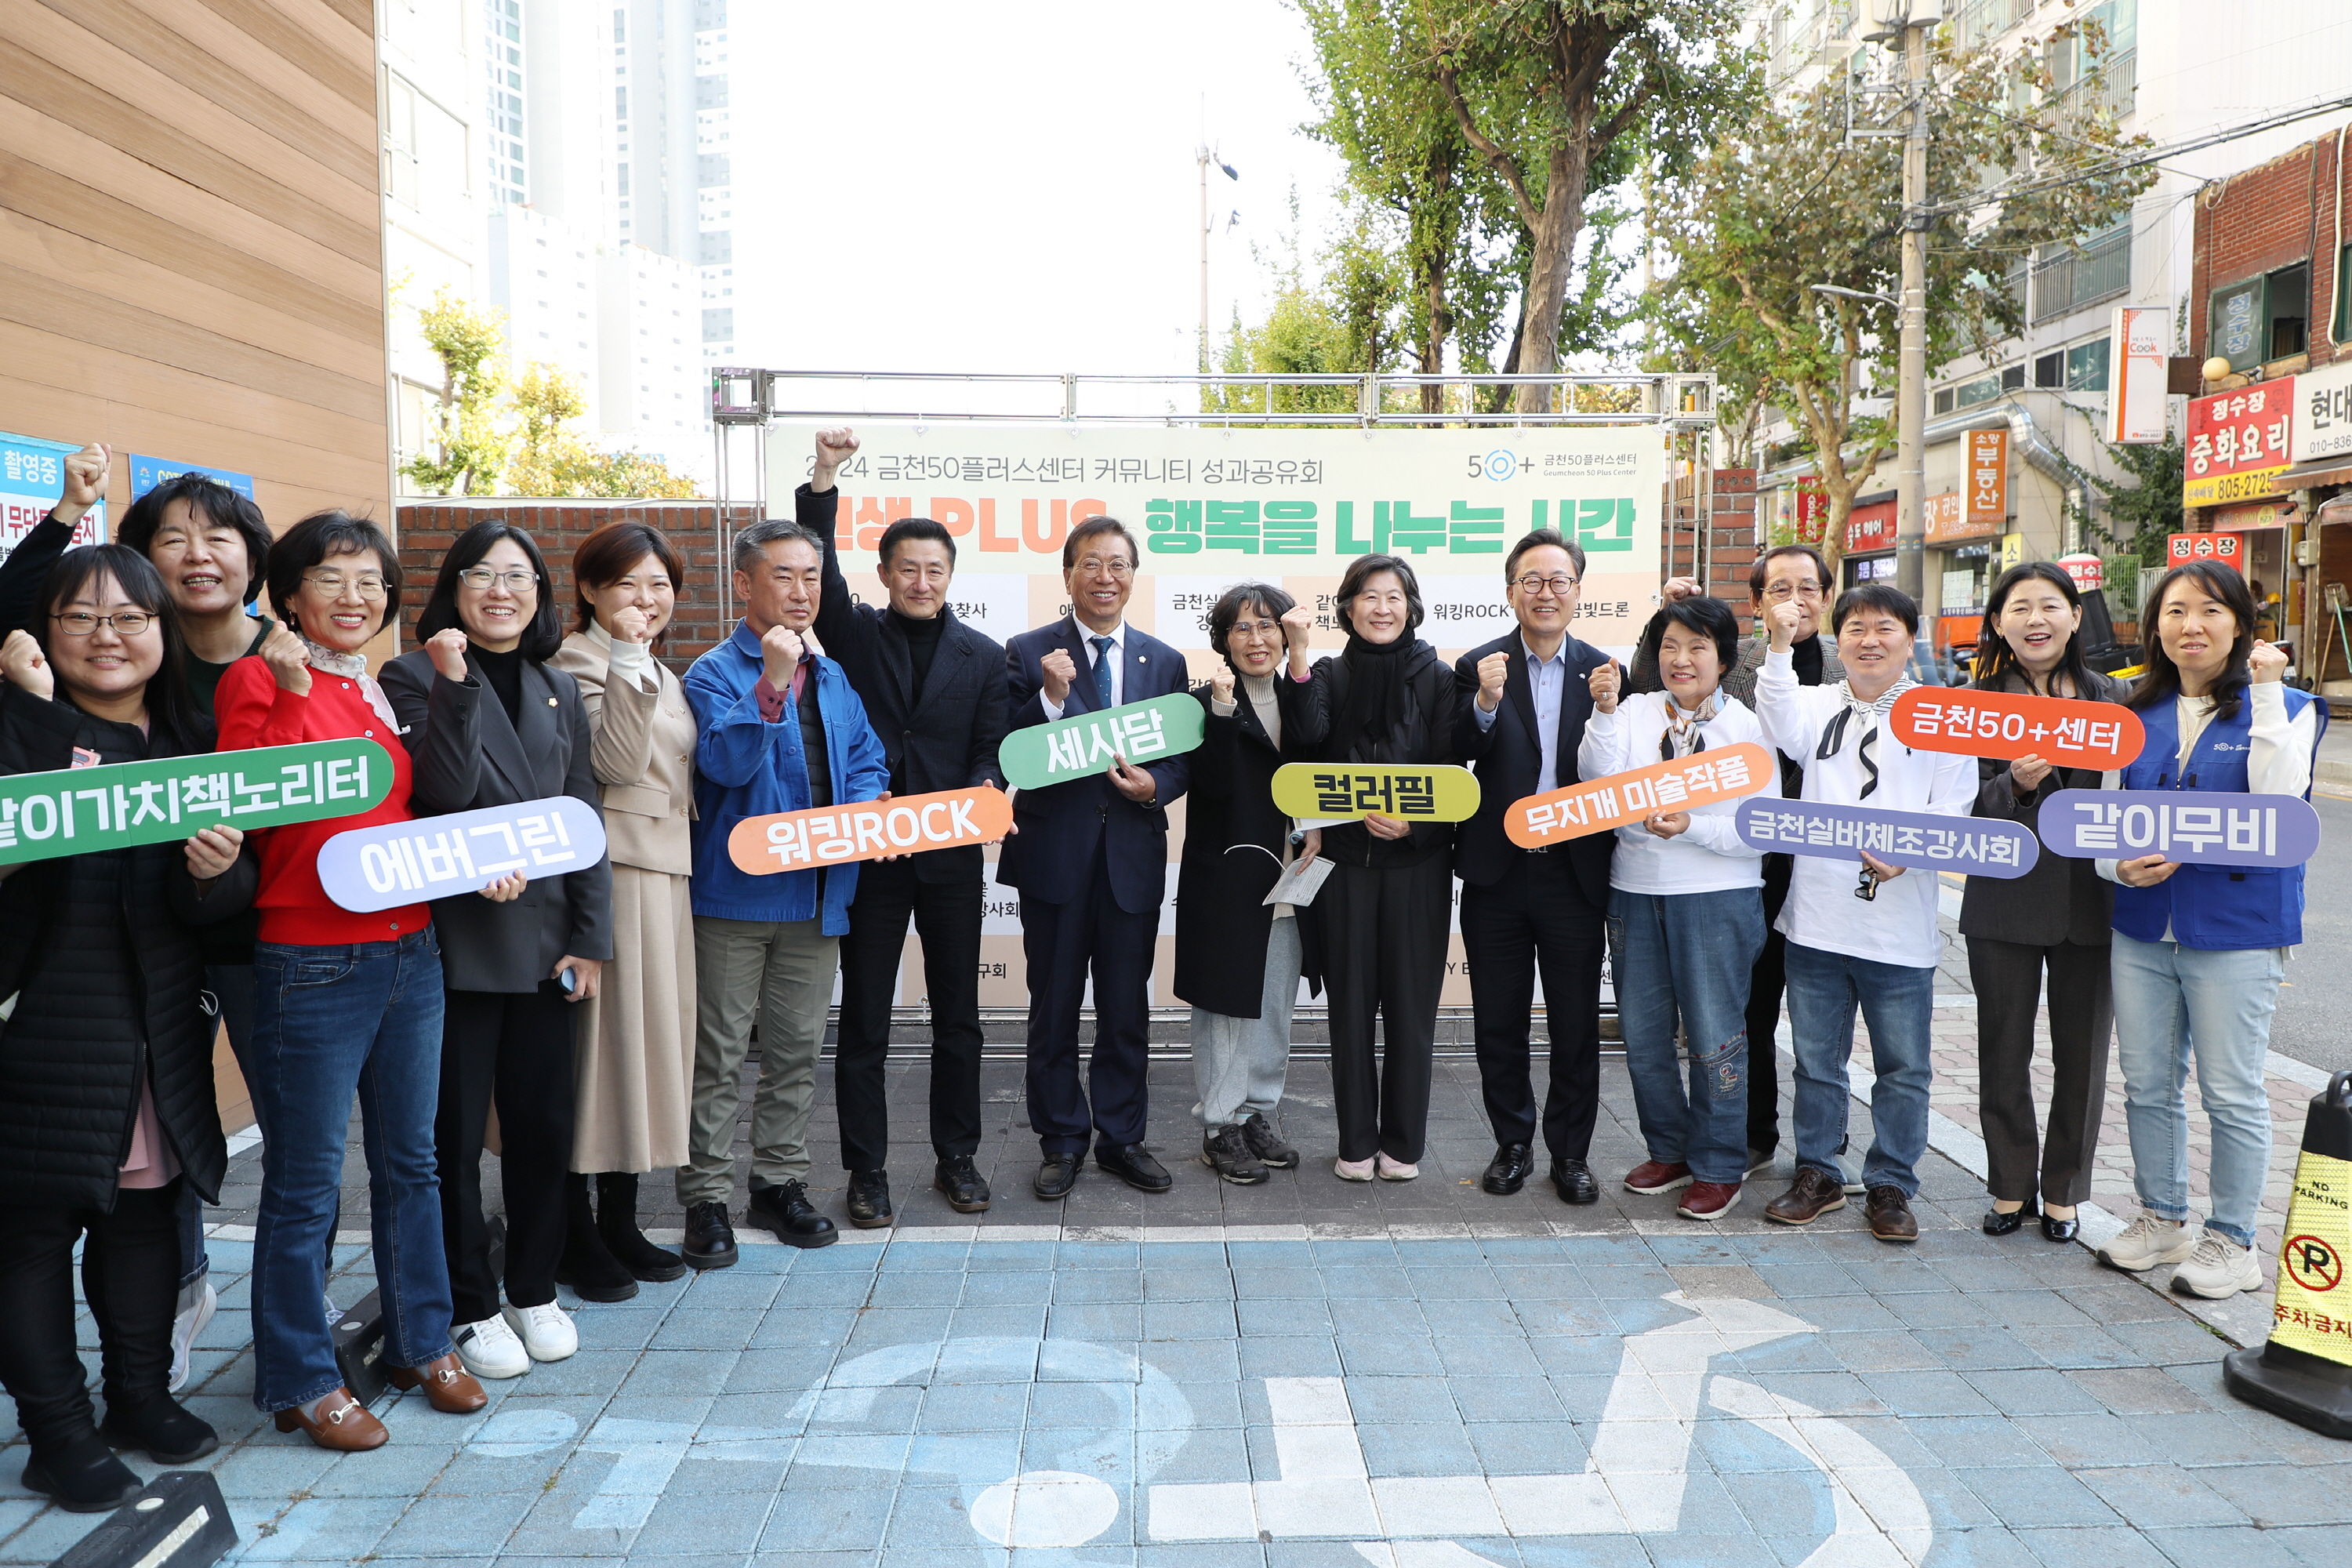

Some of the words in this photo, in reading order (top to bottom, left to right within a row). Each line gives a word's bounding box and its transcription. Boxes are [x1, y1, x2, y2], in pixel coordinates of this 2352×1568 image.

[2227, 292, 2252, 354] 정수장
[2130, 342, 2157, 353] Cook
[2212, 390, 2266, 421] 정수장
[1544, 453, 1637, 467] 금천50플러스센터
[1975, 434, 2000, 445] 소망
[2190, 414, 2290, 474] 중화요리
[4, 449, 57, 485] 촬영중
[806, 455, 869, 478] 224
[877, 454, 1084, 482] 금천50플러스센터
[1094, 457, 1191, 484] 커뮤니티
[1201, 458, 1323, 485] 성과공유회
[1975, 447, 1999, 510] 부동산
[1145, 499, 1318, 554] 행복을
[1336, 500, 1504, 554] 나누는
[2173, 537, 2237, 557] 정수장
[1433, 604, 1510, 620] 워킹ROCK
[1046, 708, 1167, 774] 세사담
[1911, 702, 2122, 755] 금천50+센터
[1313, 774, 1436, 815] 컬러필
[1525, 787, 1619, 837] 무지개
[1626, 754, 1751, 811] 미술작품
[766, 797, 982, 866] 워킹ROCK
[1748, 808, 2021, 867] 금천실버체조강사회
[2073, 803, 2277, 856] 같이무비
[359, 811, 575, 894] 에버그린
[2294, 1185, 2349, 1210] PARKING
[2312, 1181, 2330, 1192] NO
[2275, 1303, 2352, 1339] 주차금지
